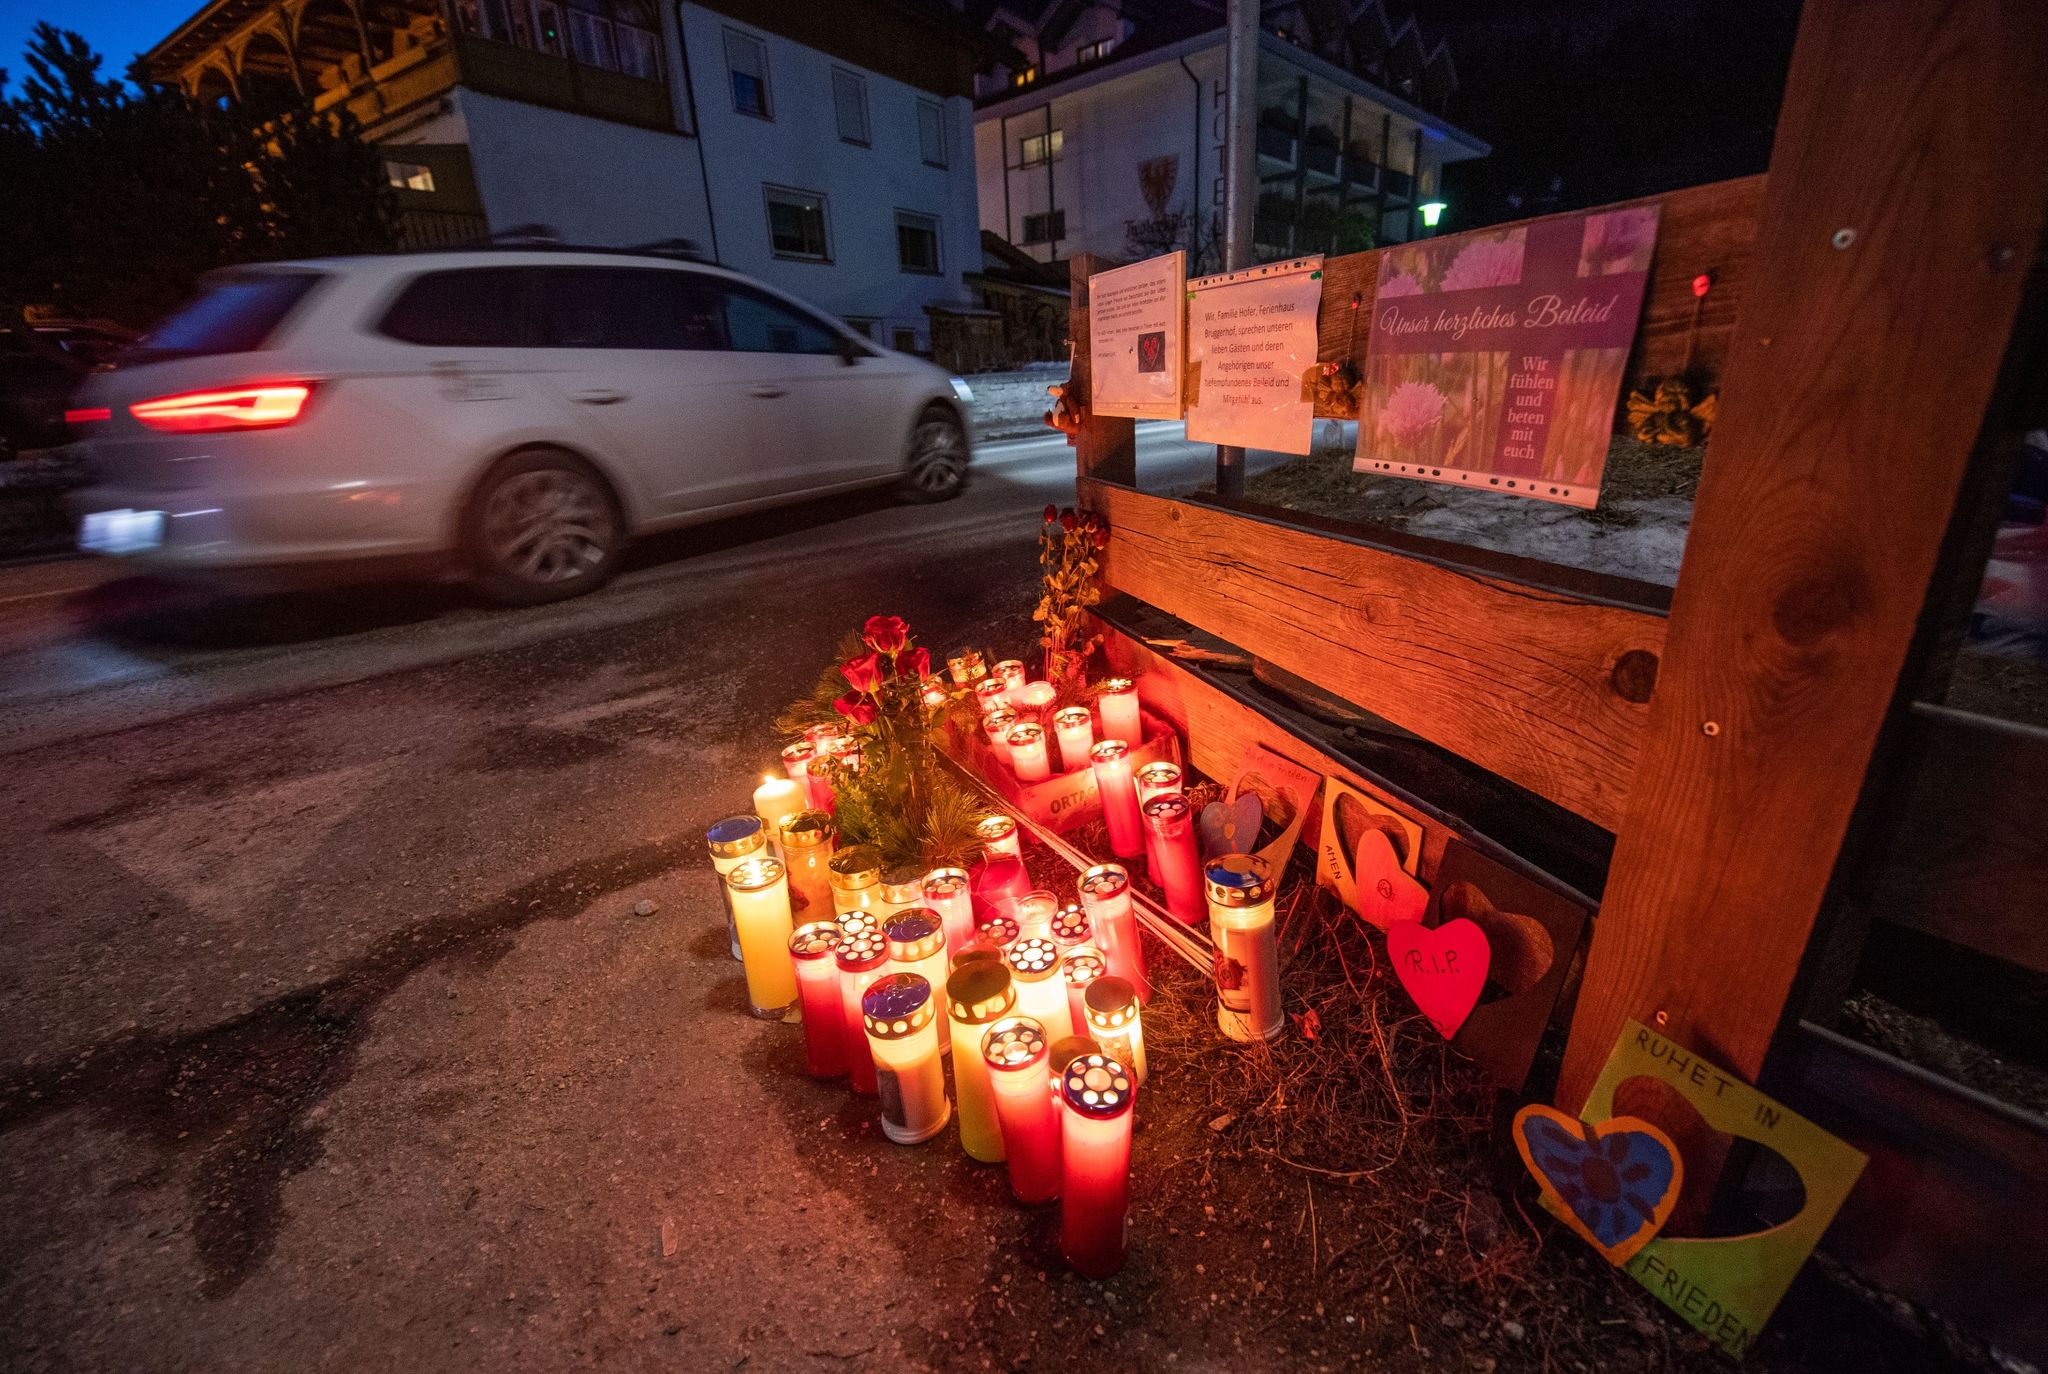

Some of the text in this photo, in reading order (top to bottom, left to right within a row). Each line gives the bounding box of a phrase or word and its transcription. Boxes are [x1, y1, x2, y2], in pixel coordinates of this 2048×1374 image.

[1217, 309, 1238, 320] Familie
[1239, 306, 1258, 317] Hofer,
[1259, 302, 1295, 315] Ferienhaus
[1380, 294, 1619, 341] Unser herzliches Beileid
[1238, 324, 1266, 336] sprechen
[1267, 322, 1293, 333] unseren
[1229, 343, 1250, 353] Gästen
[1251, 343, 1264, 352] und
[1265, 341, 1284, 351] deren
[1217, 360, 1275, 372] Angehörigen unser
[1522, 356, 1549, 372] Wir
[1275, 377, 1289, 387] und
[1510, 374, 1554, 390] fühlen
[1516, 393, 1544, 407] und
[1507, 409, 1545, 426] beten
[1511, 428, 1534, 442] mit
[1504, 444, 1535, 461] euch
[1326, 845, 1342, 880] AMEN
[1404, 949, 1461, 976] R.I.P.
[1635, 1028, 1782, 1131] RUHET IN
[1642, 1255, 1757, 1348] FRIEDEN
